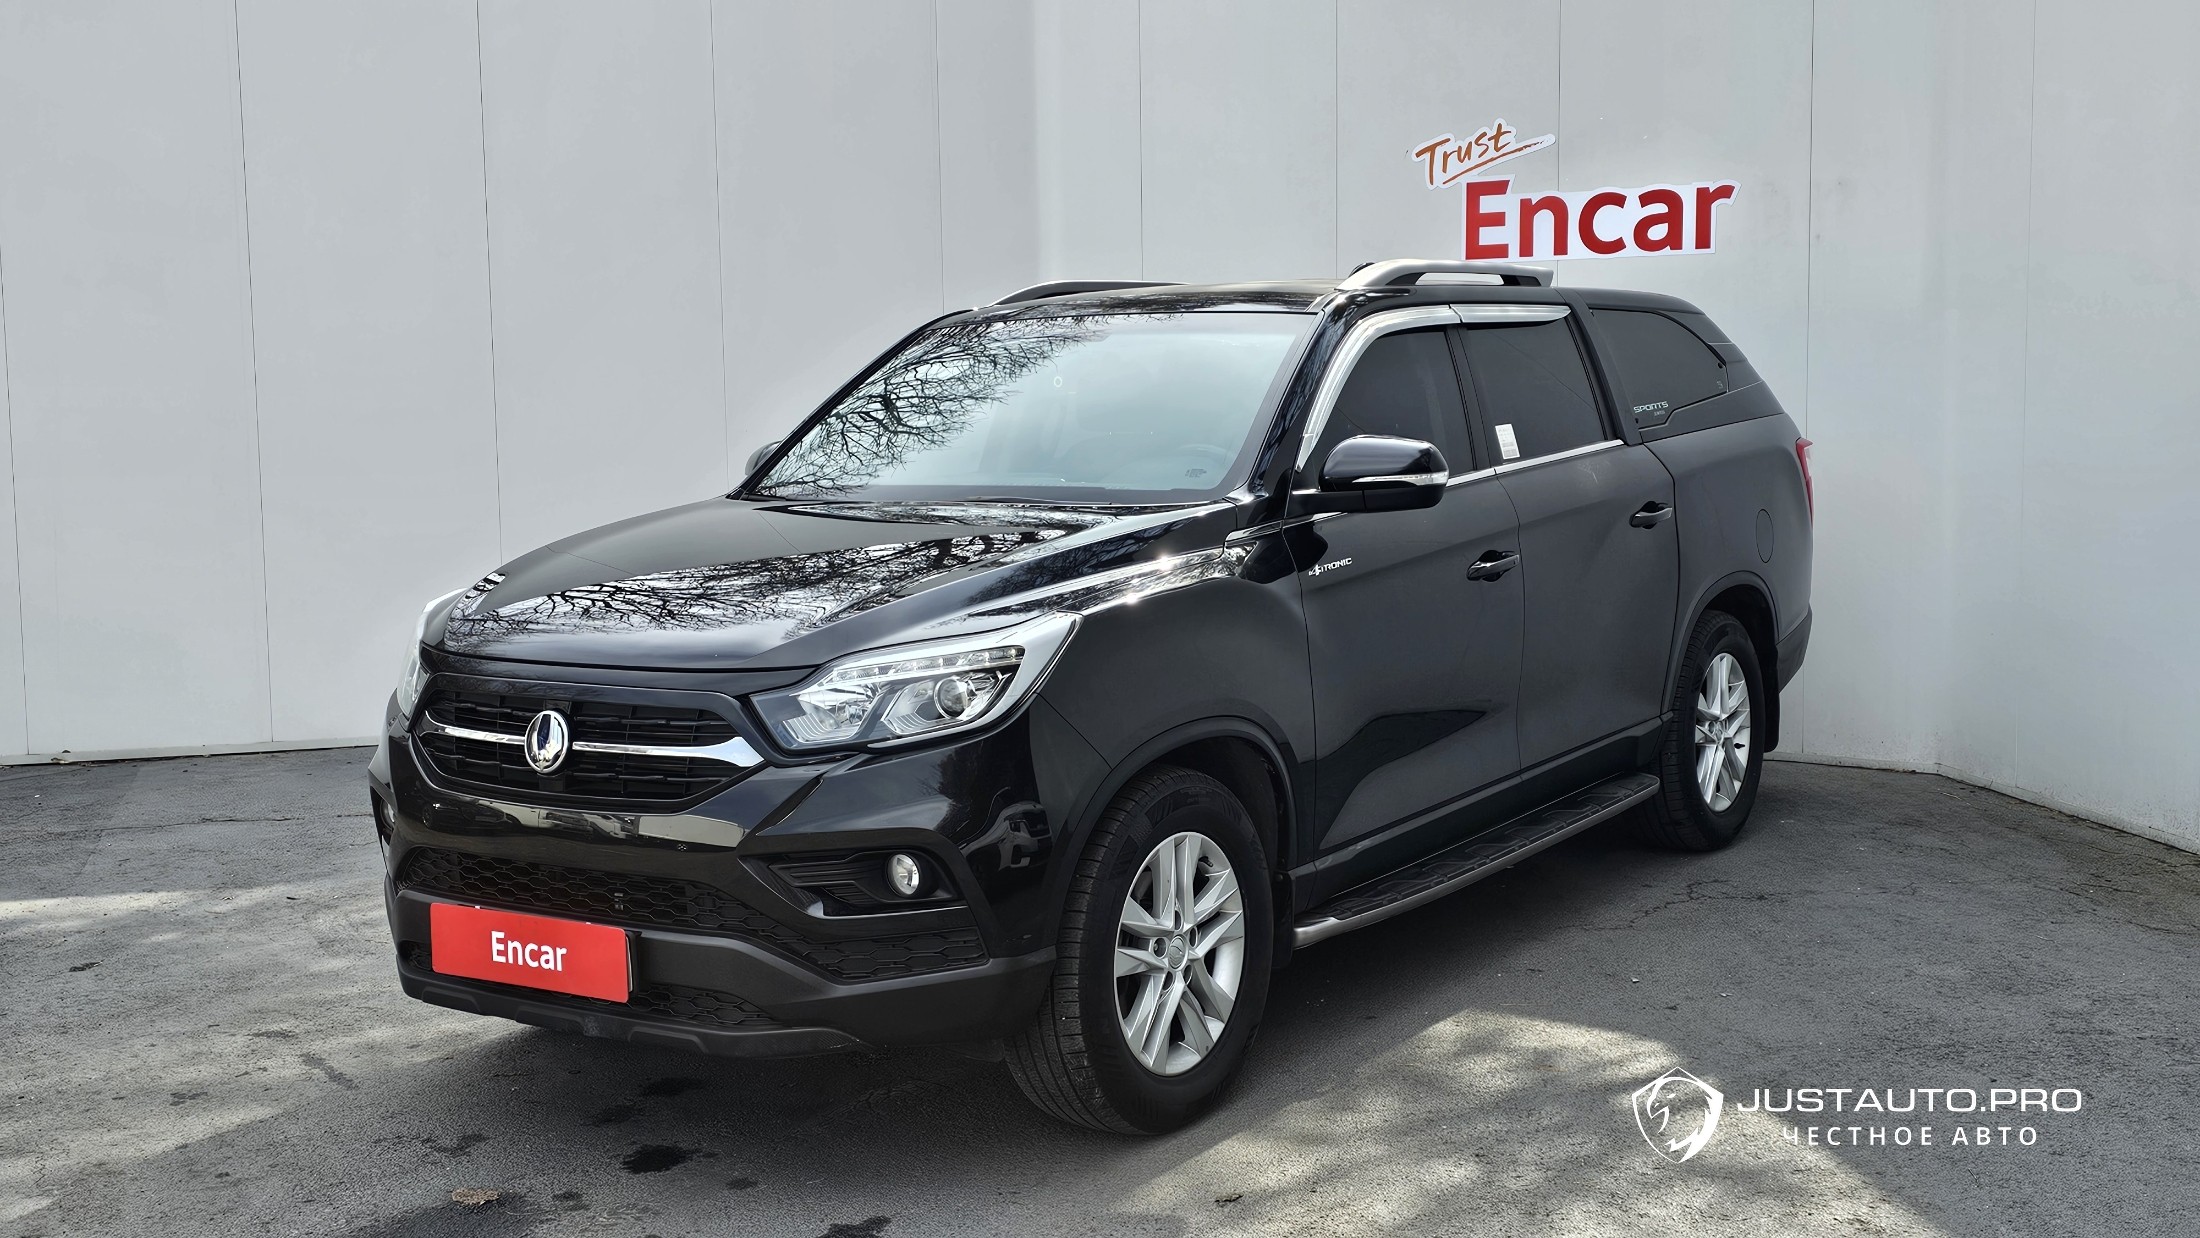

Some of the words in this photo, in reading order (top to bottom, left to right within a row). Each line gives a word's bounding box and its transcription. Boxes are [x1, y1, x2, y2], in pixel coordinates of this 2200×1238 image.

[1415, 122, 1512, 185] Trust
[1465, 179, 1736, 260] Encar
[1633, 400, 1669, 413] SPORTS
[491, 930, 567, 972] Encar
